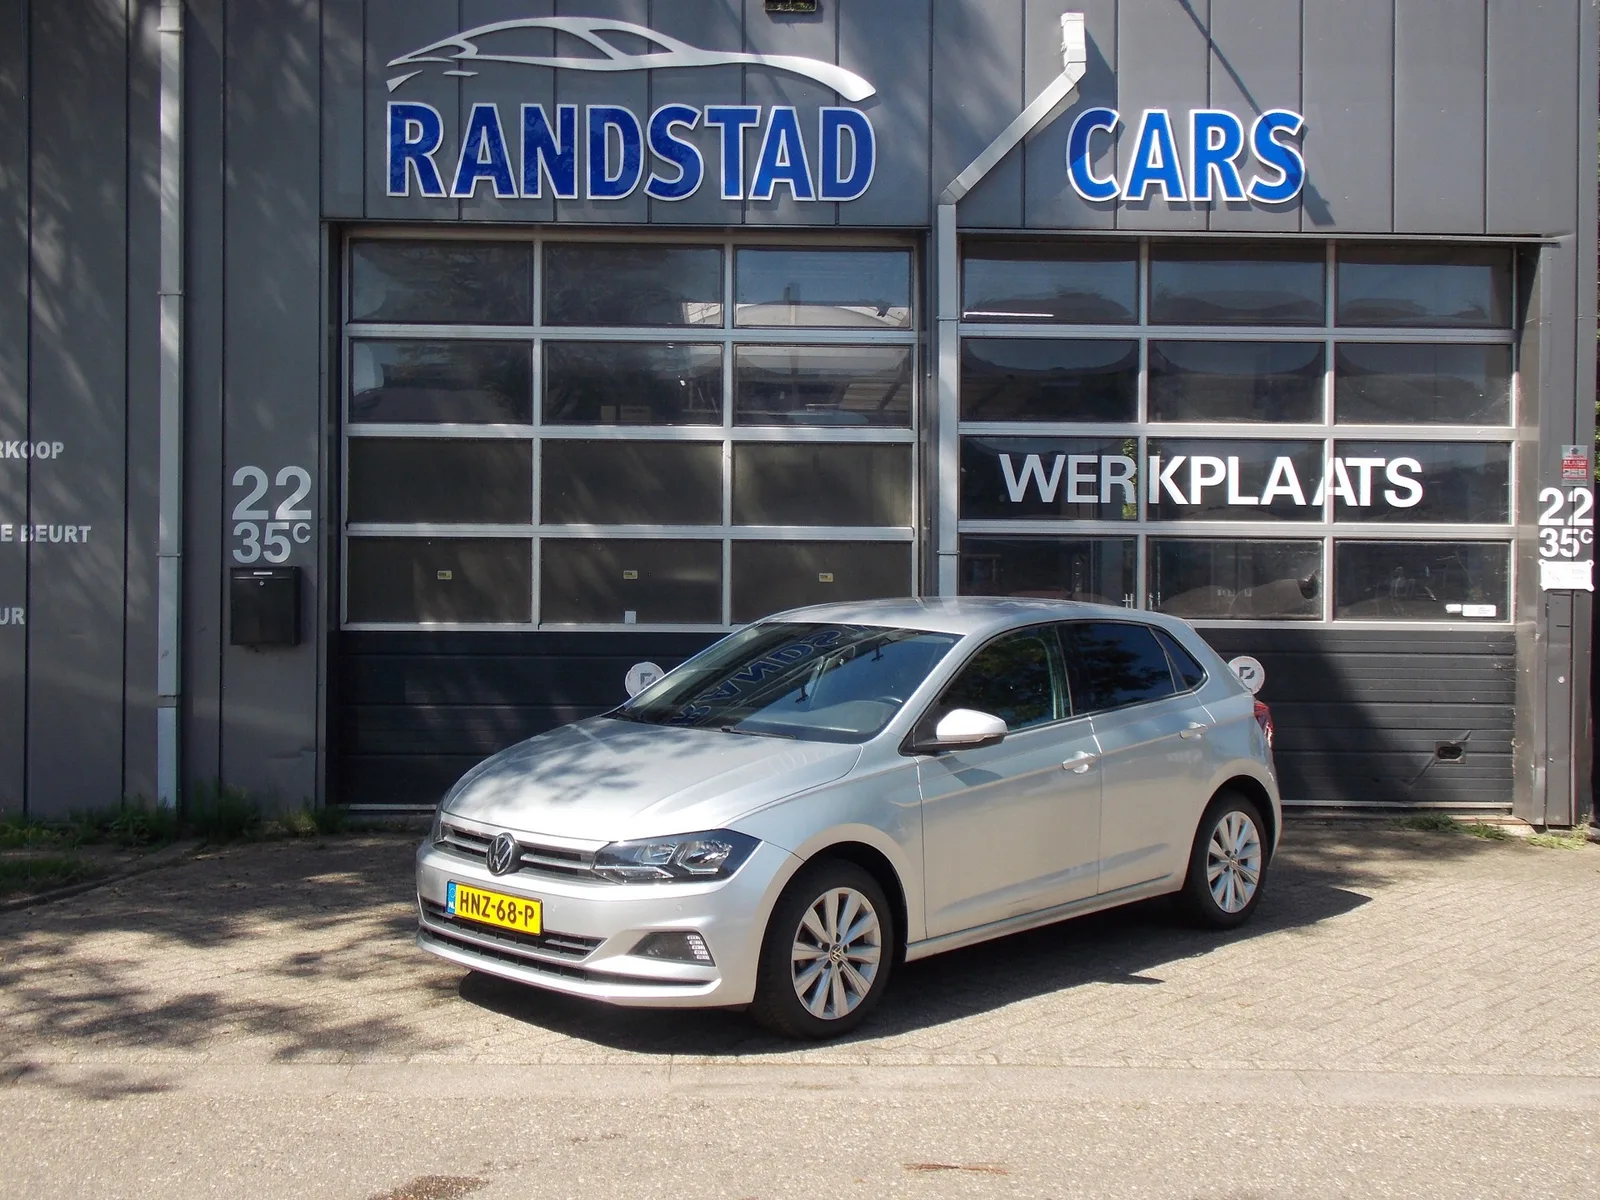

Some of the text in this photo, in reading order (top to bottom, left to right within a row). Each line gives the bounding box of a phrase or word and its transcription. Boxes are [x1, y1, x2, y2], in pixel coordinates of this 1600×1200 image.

[386, 101, 1306, 204] RANDSTAD CARS
[232, 465, 312, 521] 22
[999, 453, 1424, 509] WERKPLAATS
[1538, 487, 1594, 526] 22
[20, 525, 92, 544] BEURT
[459, 890, 536, 928] HNZ-68-P
